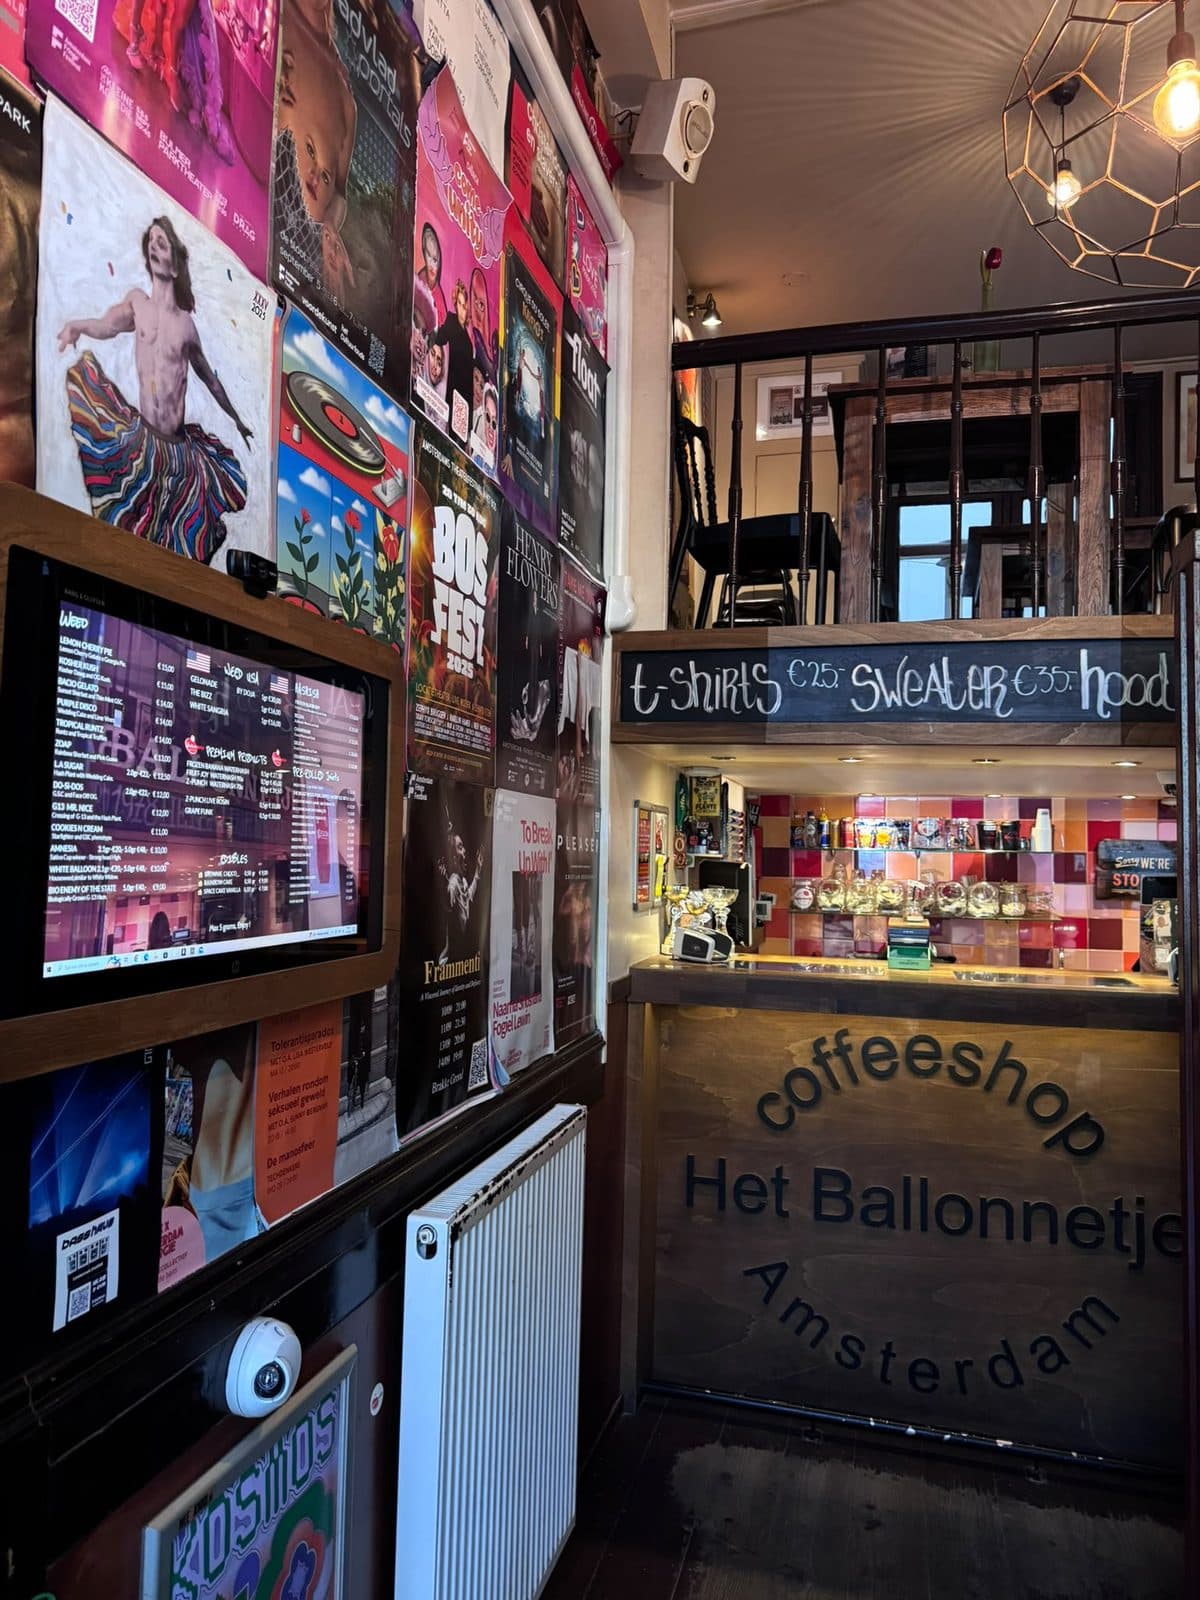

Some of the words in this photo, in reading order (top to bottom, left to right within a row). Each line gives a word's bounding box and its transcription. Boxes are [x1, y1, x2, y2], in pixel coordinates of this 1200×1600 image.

[233, 211, 257, 242] DRAG
[432, 504, 489, 607] BOS
[514, 521, 554, 579] HENRY
[507, 545, 559, 610] FLOWERS
[431, 582, 485, 668] FEST
[446, 651, 475, 680] 2025
[77, 680, 99, 693] GELATO
[56, 718, 84, 731] TROPICAL
[79, 804, 93, 813] NICE
[83, 825, 104, 834] CREAM
[520, 820, 531, 844] To
[70, 864, 97, 873] BALLOON
[518, 851, 531, 879] Up
[531, 851, 548, 874] With
[1115, 856, 1141, 868] Sorry
[1140, 857, 1171, 870] WE'RE
[424, 951, 481, 985] Frammenti
[268, 1084, 302, 1105] Verhalen
[302, 1075, 329, 1093] rondom
[268, 1100, 300, 1119] seksueel
[300, 1088, 326, 1109] geweld
[757, 1028, 1106, 1158] coffeeshop
[267, 1154, 278, 1169] De
[685, 1153, 791, 1219] Het
[813, 1167, 1186, 1271] Ballonnetje
[743, 1260, 1121, 1396] Amsterdam
